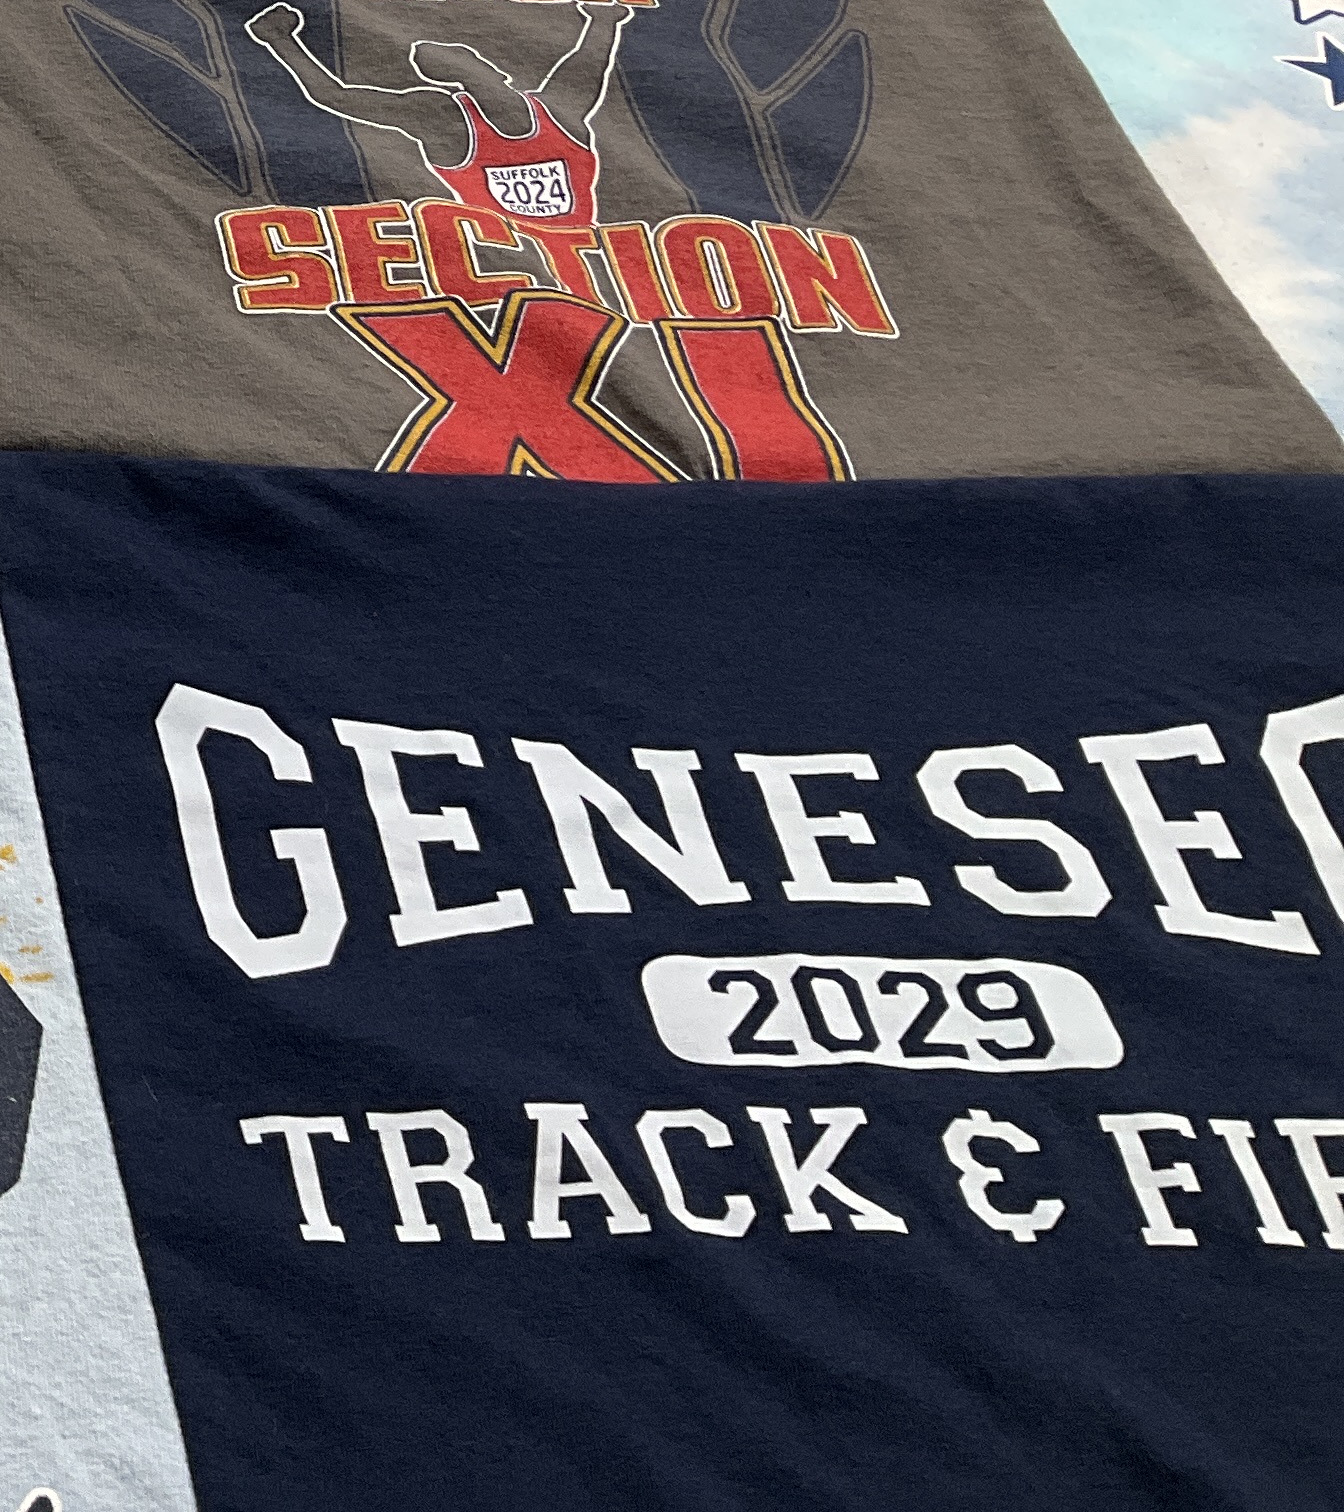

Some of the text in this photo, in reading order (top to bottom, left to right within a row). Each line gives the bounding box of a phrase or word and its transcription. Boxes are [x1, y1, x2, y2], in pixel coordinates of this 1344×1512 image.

[490, 166, 561, 180] SUFFOLK
[495, 178, 566, 204] 2024
[509, 203, 561, 215] COUNTY
[214, 195, 901, 339] SECTION
[327, 287, 858, 483] XI
[707, 968, 1056, 1061] 2029
[240, 1100, 910, 1245] TRACK
[941, 1108, 1066, 1244] &
